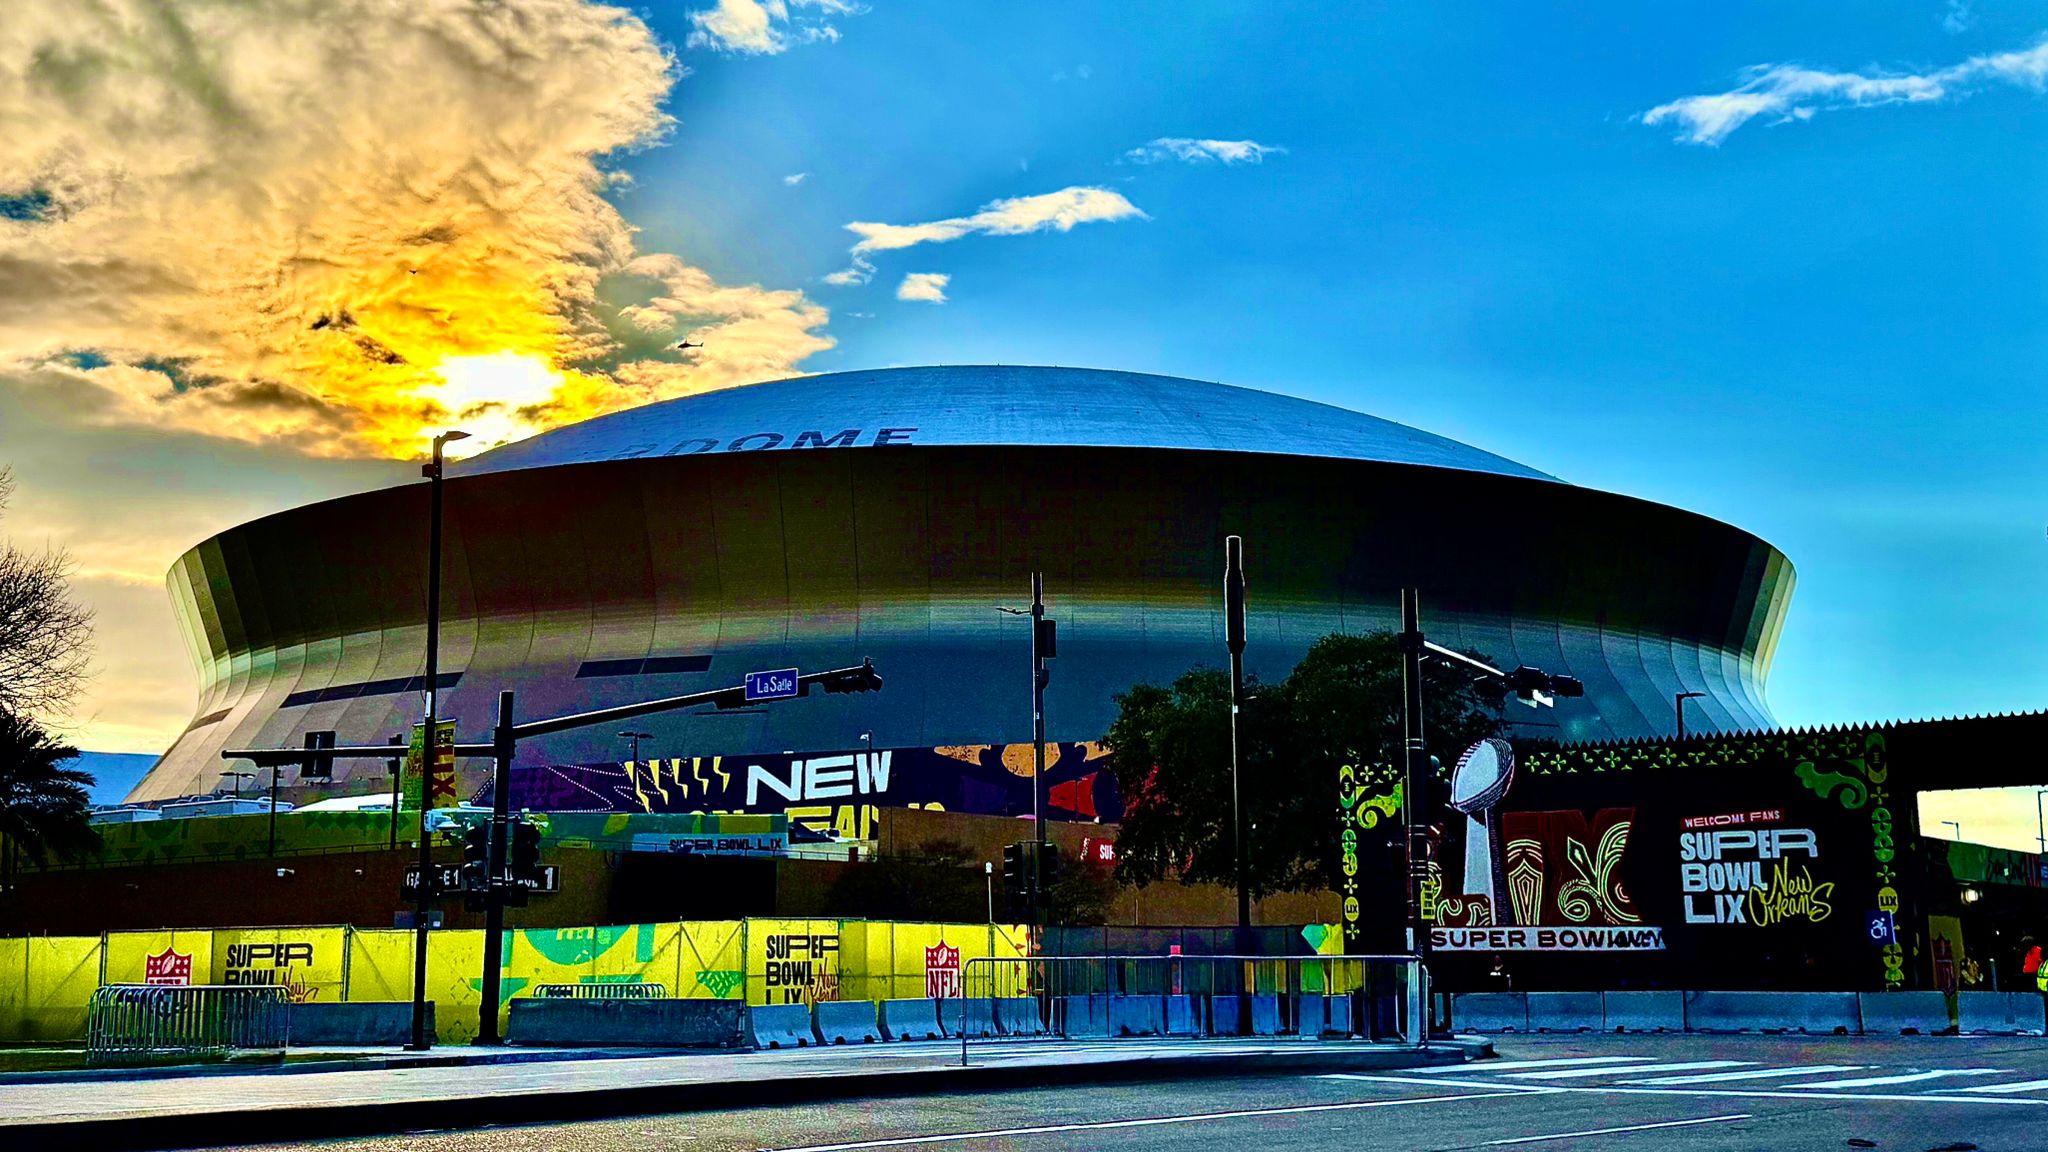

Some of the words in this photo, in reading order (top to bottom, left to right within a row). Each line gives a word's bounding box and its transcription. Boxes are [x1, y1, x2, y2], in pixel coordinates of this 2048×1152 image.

[757, 676, 792, 693] LaSalle
[746, 751, 892, 805] NEW
[1685, 815, 1745, 827] WELCOME
[1751, 810, 1780, 822] FANS
[1680, 829, 1818, 860] SUPER
[1682, 862, 1768, 892] BOWL
[1684, 895, 1746, 923] LIX
[1432, 930, 1526, 948] SUPER
[227, 943, 313, 968] SUPER
[766, 961, 815, 986] BOWL
[928, 969, 958, 998] NFL
